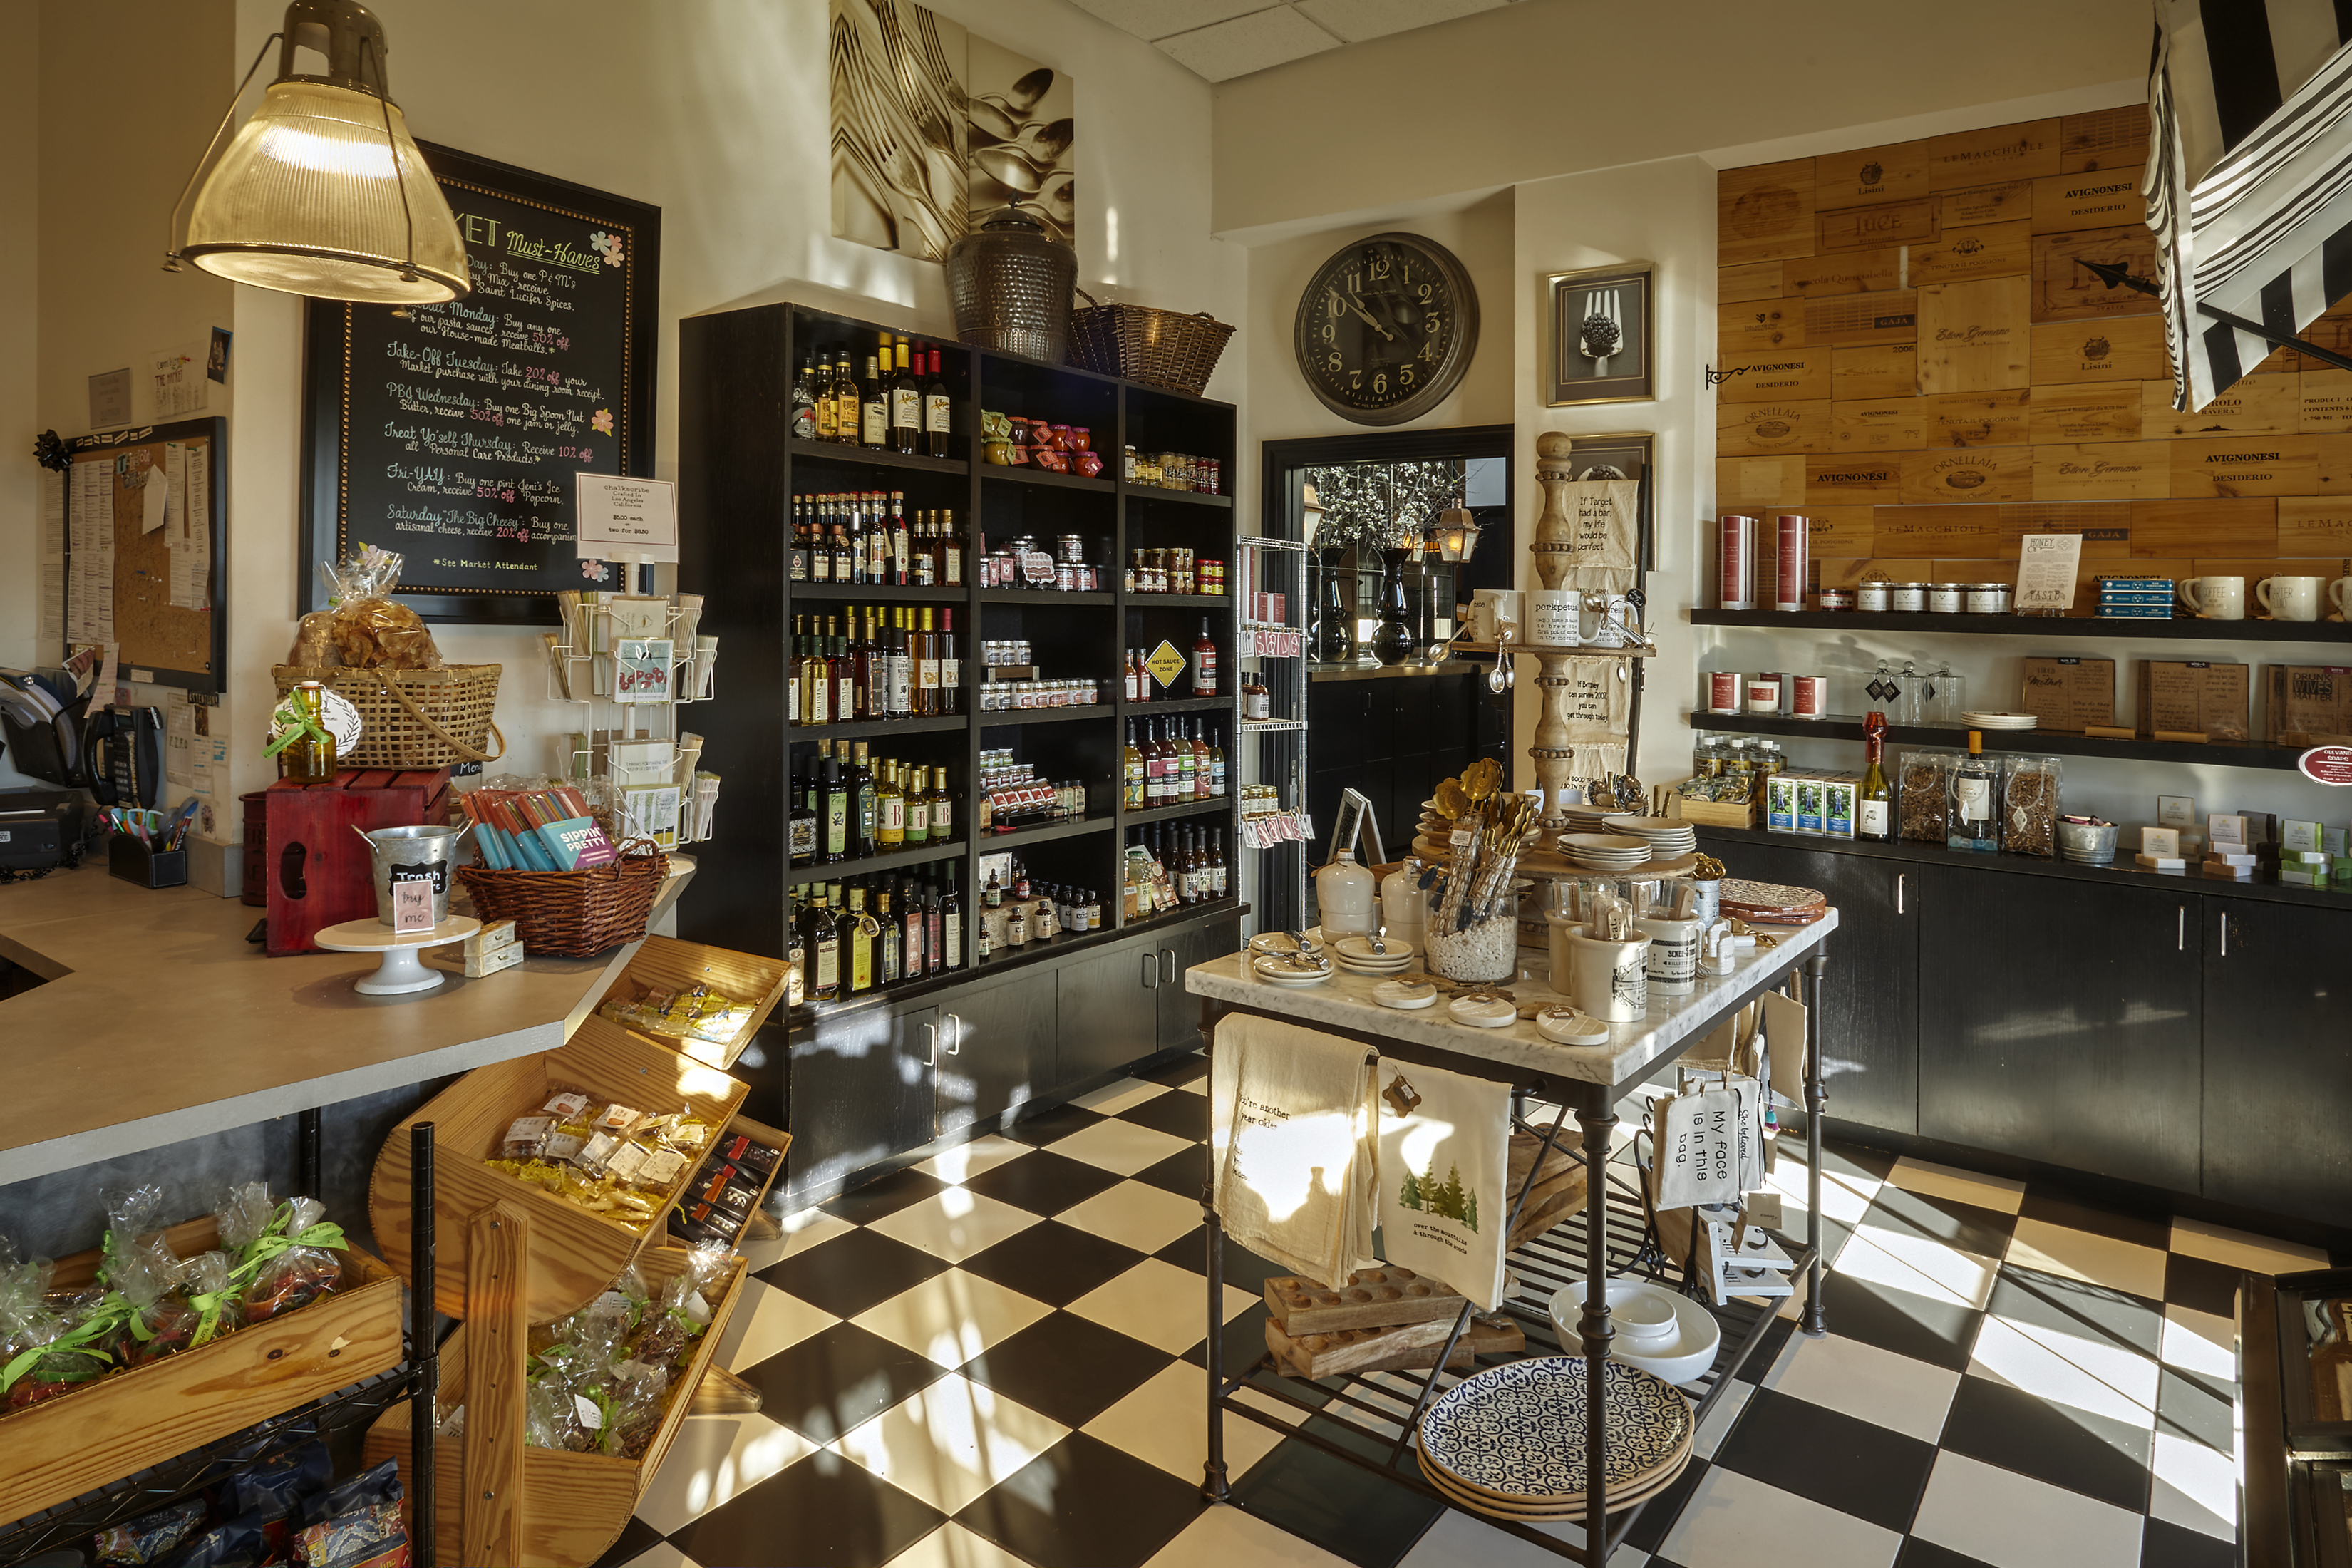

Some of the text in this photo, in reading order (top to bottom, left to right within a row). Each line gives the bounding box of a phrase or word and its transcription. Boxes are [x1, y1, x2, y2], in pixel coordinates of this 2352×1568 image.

[1858, 186, 1884, 195] Lisini
[2065, 182, 2132, 198] AVIGNONESI
[2071, 204, 2125, 215] DESIDERIO
[1369, 259, 1390, 282] 12
[1404, 265, 1410, 284] 1
[1346, 272, 1362, 294] 11
[478, 282, 574, 311] Saint Lucifer Spices.
[1418, 284, 1433, 305] 2
[1326, 296, 1347, 319] 10
[450, 301, 499, 329] Monday:
[504, 314, 523, 332] Buy
[527, 322, 544, 336] any
[547, 326, 562, 336] one
[1425, 312, 1440, 333] 3
[1322, 324, 1336, 344] 9
[1935, 325, 2011, 342] Ettore Germano
[1417, 341, 1433, 362] 4
[1328, 352, 1342, 372] 8
[1751, 362, 1805, 372] AVIGNONESI
[2081, 361, 2112, 371] Lisini
[399, 359, 604, 403] Market purchase with your dining room receipt.
[1349, 370, 1362, 389] 7
[1399, 364, 1414, 385] 5
[1373, 374, 1387, 394] 6
[399, 398, 579, 437] Butter, receive 50% off one jam or jelly.
[1745, 407, 1800, 424] ORNELLAIA
[385, 421, 416, 440] Treat
[460, 432, 516, 456] Thursday:
[522, 441, 555, 456] Receive
[559, 446, 577, 458] 10%
[579, 448, 593, 463] off
[1933, 456, 1997, 473] ORNELLAIA
[2205, 453, 2280, 463] AVIGNONESI
[1817, 472, 1887, 483] AVIGNONESI
[2059, 460, 2142, 478] Ettore Germano
[407, 482, 564, 507] Cream, receive 50% off Popcorn.
[604, 485, 649, 493] chalkscribe
[1589, 497, 1612, 507] Target
[1599, 509, 1611, 517] bar,
[1583, 521, 1592, 530] my
[2031, 538, 2054, 547] HONEY
[2203, 587, 2226, 599] COFFEE
[1582, 681, 1599, 690] Britney
[2028, 675, 2063, 689] Mother
[2293, 673, 2331, 681] DRUNK
[2293, 681, 2333, 694] WIVES
[2294, 693, 2333, 701] MATTER
[1576, 713, 1594, 721] through
[559, 827, 602, 842] SIPPIN'
[566, 837, 605, 852] PRETTY
[401, 892, 425, 906] try
[406, 914, 425, 924] me
[1259, 1104, 1291, 1121] another
[1738, 1109, 1749, 1160] She believed
[1676, 1133, 1688, 1167] bag.
[1711, 1111, 1727, 1180] My face
[1419, 1232, 1444, 1244] through
[1445, 1238, 1453, 1247] the
[1453, 1244, 1468, 1255] woods
[1440, 1227, 1468, 1246] mountains
[357, 1544, 386, 1559] GRAGNANO
